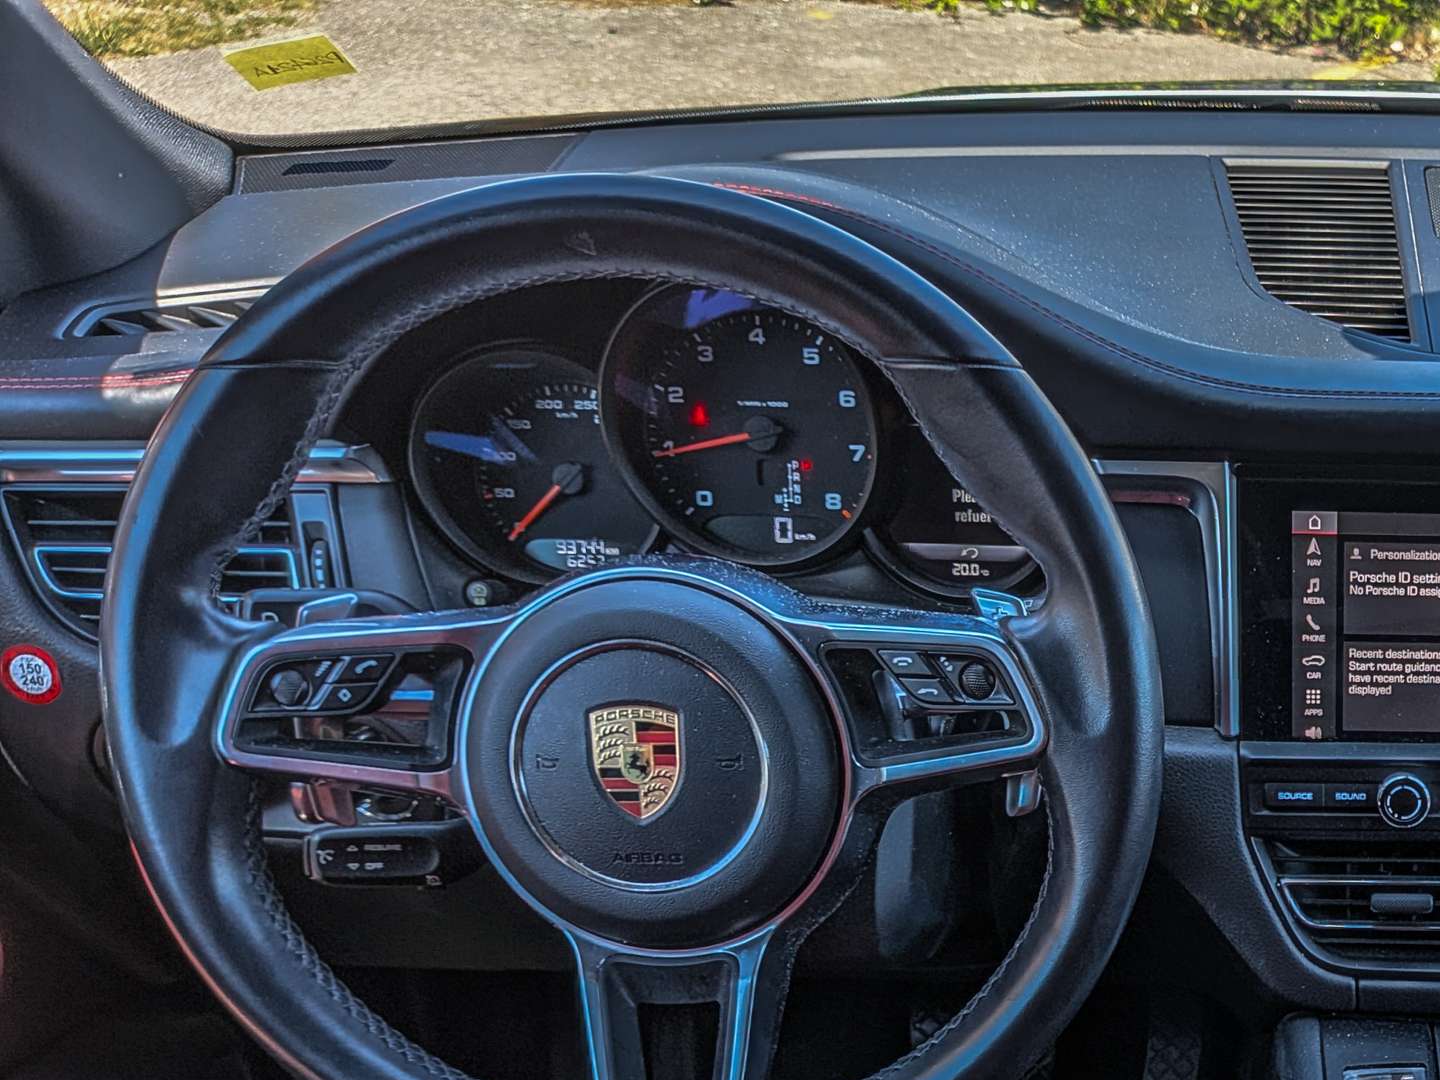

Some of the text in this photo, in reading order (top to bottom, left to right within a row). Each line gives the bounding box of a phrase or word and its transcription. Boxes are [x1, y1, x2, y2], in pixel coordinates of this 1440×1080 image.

[748, 328, 766, 344] 4
[697, 345, 714, 362] 3
[802, 348, 820, 365] 5
[667, 386, 685, 403] 2
[839, 390, 856, 407] 6
[536, 400, 562, 409] 200
[848, 445, 866, 462] 7
[494, 488, 515, 498] 50
[695, 490, 713, 507] 0
[825, 493, 842, 510] 8
[774, 517, 793, 544] 0
[952, 563, 980, 576] 20.0
[1350, 571, 1396, 583] Porsche
[1399, 572, 1411, 583] ID
[1349, 585, 1363, 595] No
[1365, 585, 1405, 596] Porsche
[1407, 586, 1418, 596] ID
[1349, 648, 1384, 659] Recent
[19, 663, 42, 674] 150
[1349, 661, 1375, 671] Start
[1377, 663, 1402, 671] route
[20, 675, 44, 686] 240
[1349, 673, 1371, 683] have
[1373, 674, 1405, 683] recent
[1349, 685, 1392, 696] displayed
[595, 709, 675, 725] PORSCHE
[1278, 792, 1313, 800] SOURCE
[1335, 792, 1366, 800] SOUND
[611, 852, 683, 864] AIRBAG
